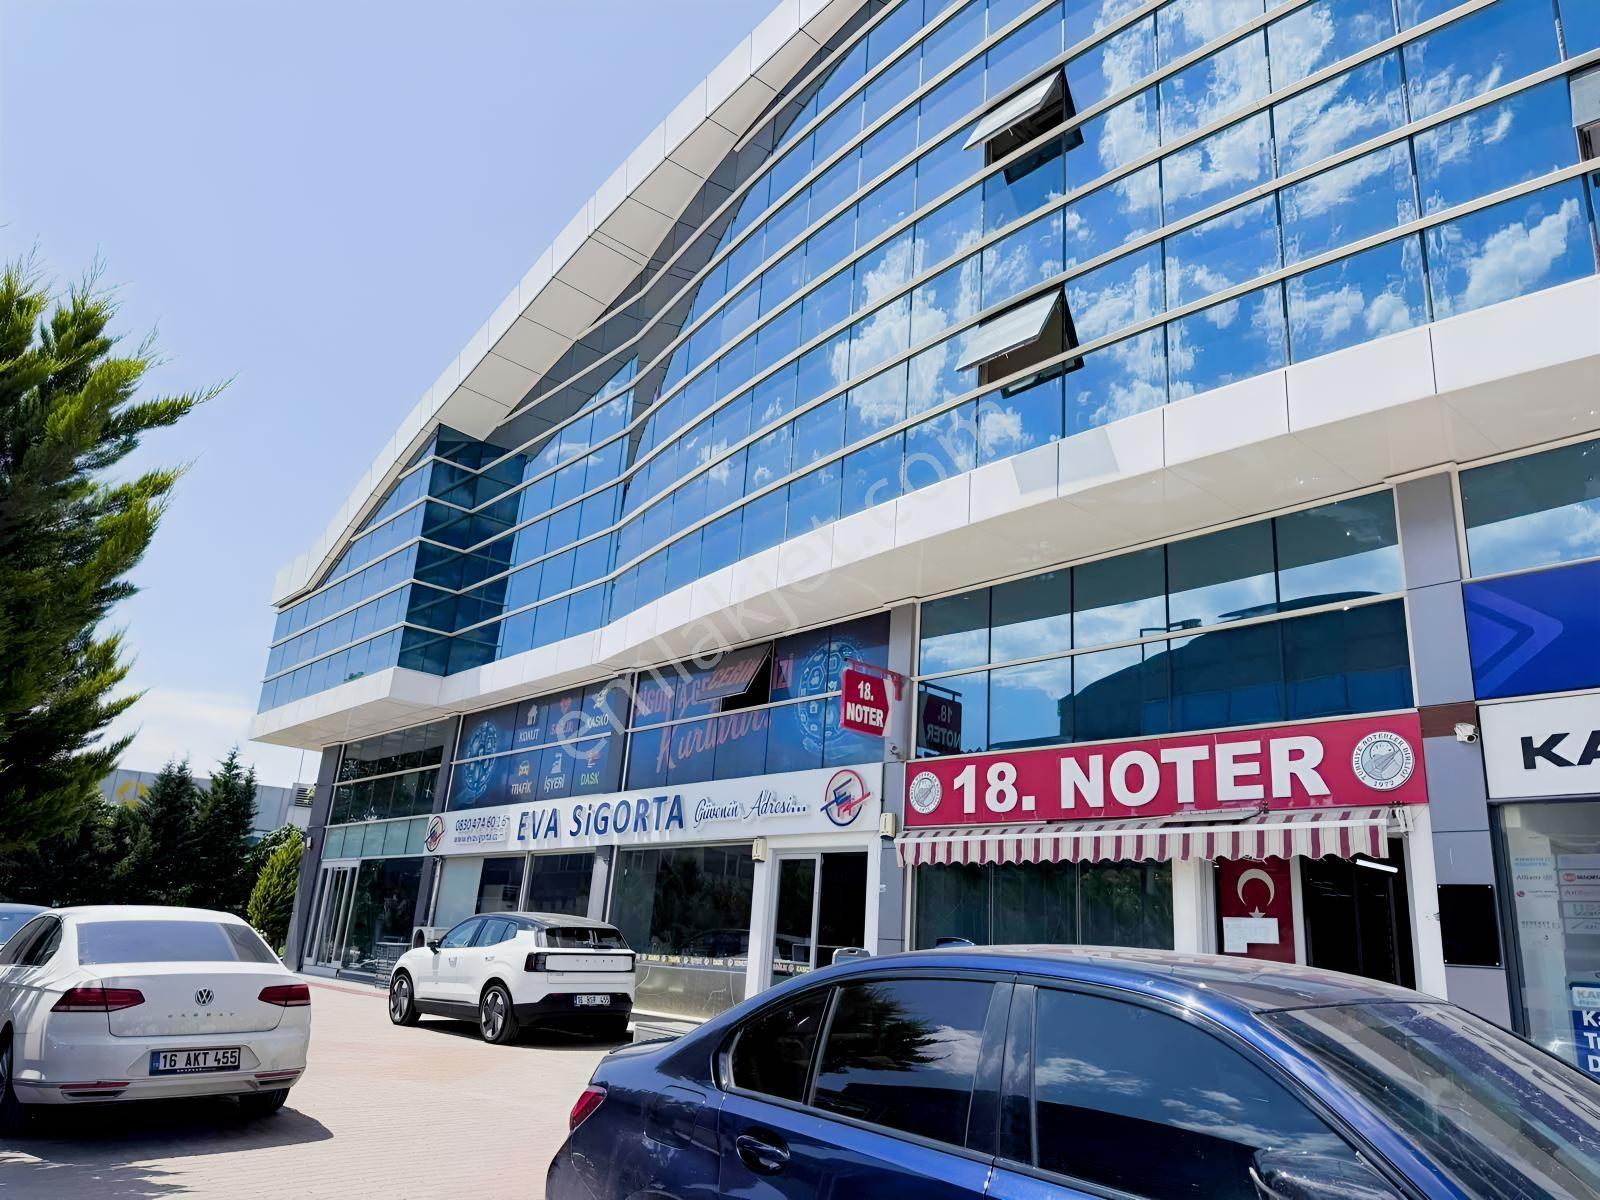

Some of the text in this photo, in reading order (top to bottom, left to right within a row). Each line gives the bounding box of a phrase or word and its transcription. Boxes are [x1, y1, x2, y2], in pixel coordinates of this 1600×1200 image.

[857, 681, 874, 701] 18.
[846, 702, 884, 728] NOTER
[580, 771, 600, 786] DASK
[953, 762, 1036, 814] 18.
[1060, 735, 1331, 810] NOTER
[517, 808, 559, 841] EVA
[162, 1053, 177, 1068] 16
[185, 1051, 209, 1067] AKT
[214, 1050, 238, 1065] 455
